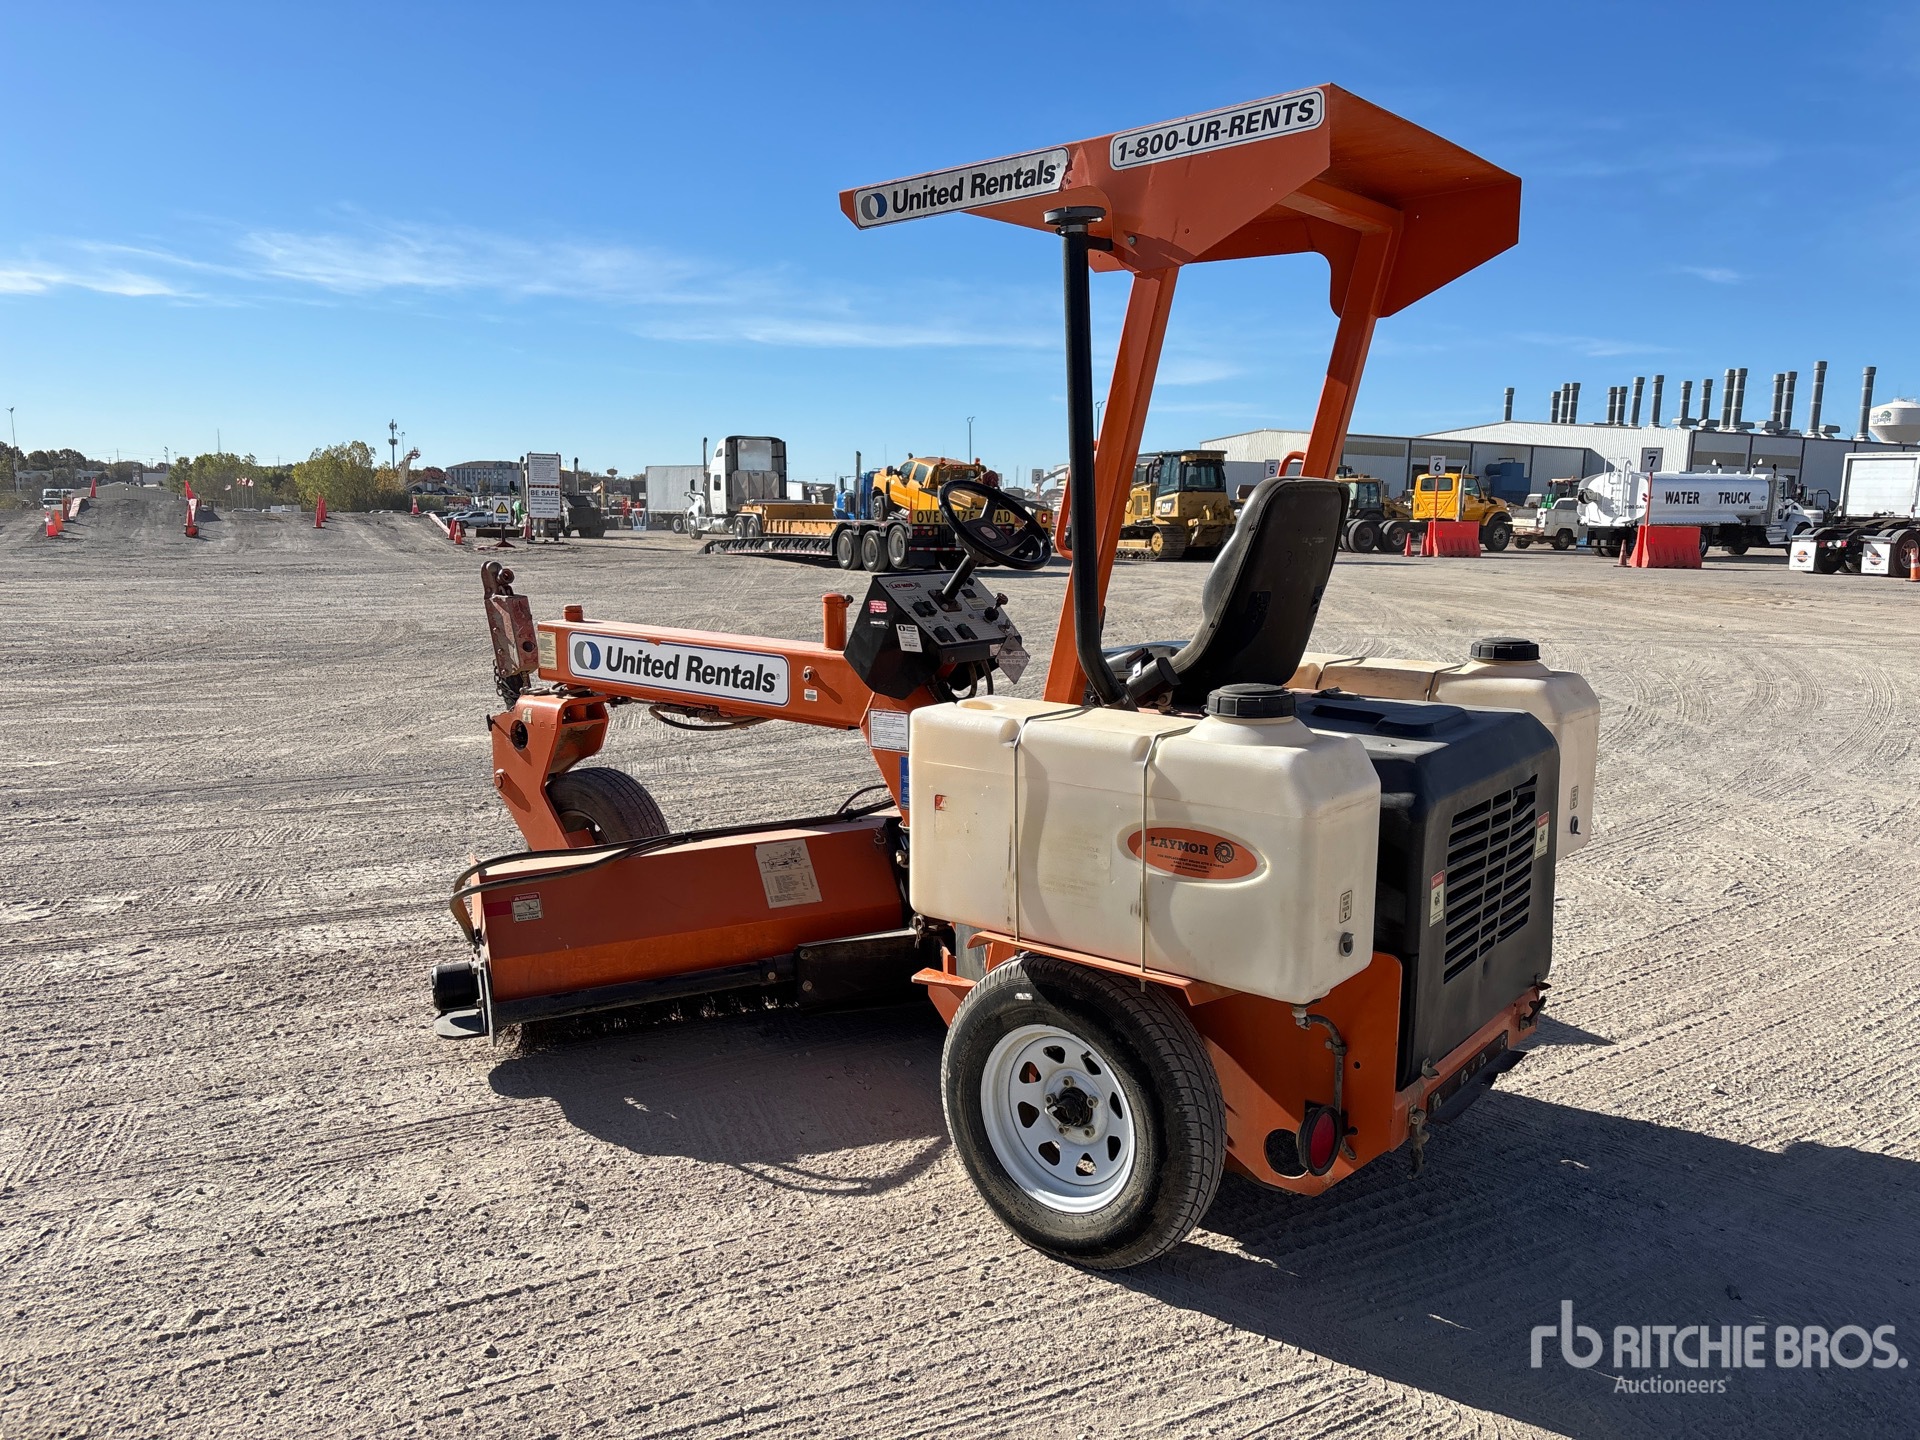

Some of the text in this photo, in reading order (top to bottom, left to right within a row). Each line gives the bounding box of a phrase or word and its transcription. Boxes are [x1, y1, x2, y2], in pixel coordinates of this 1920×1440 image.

[1118, 98, 1315, 161] 1-800-UR-RENTS
[892, 160, 1055, 214] United Rentals
[1434, 462, 1441, 471] 6
[1648, 456, 1656, 467] 7
[1269, 465, 1275, 474] 5
[1665, 491, 1751, 504] WATER TRUCK
[1161, 502, 1172, 513] CAT
[916, 510, 976, 523] OVEIZE
[606, 646, 776, 693] United Rentals
[1151, 837, 1208, 856] LAYMOR
